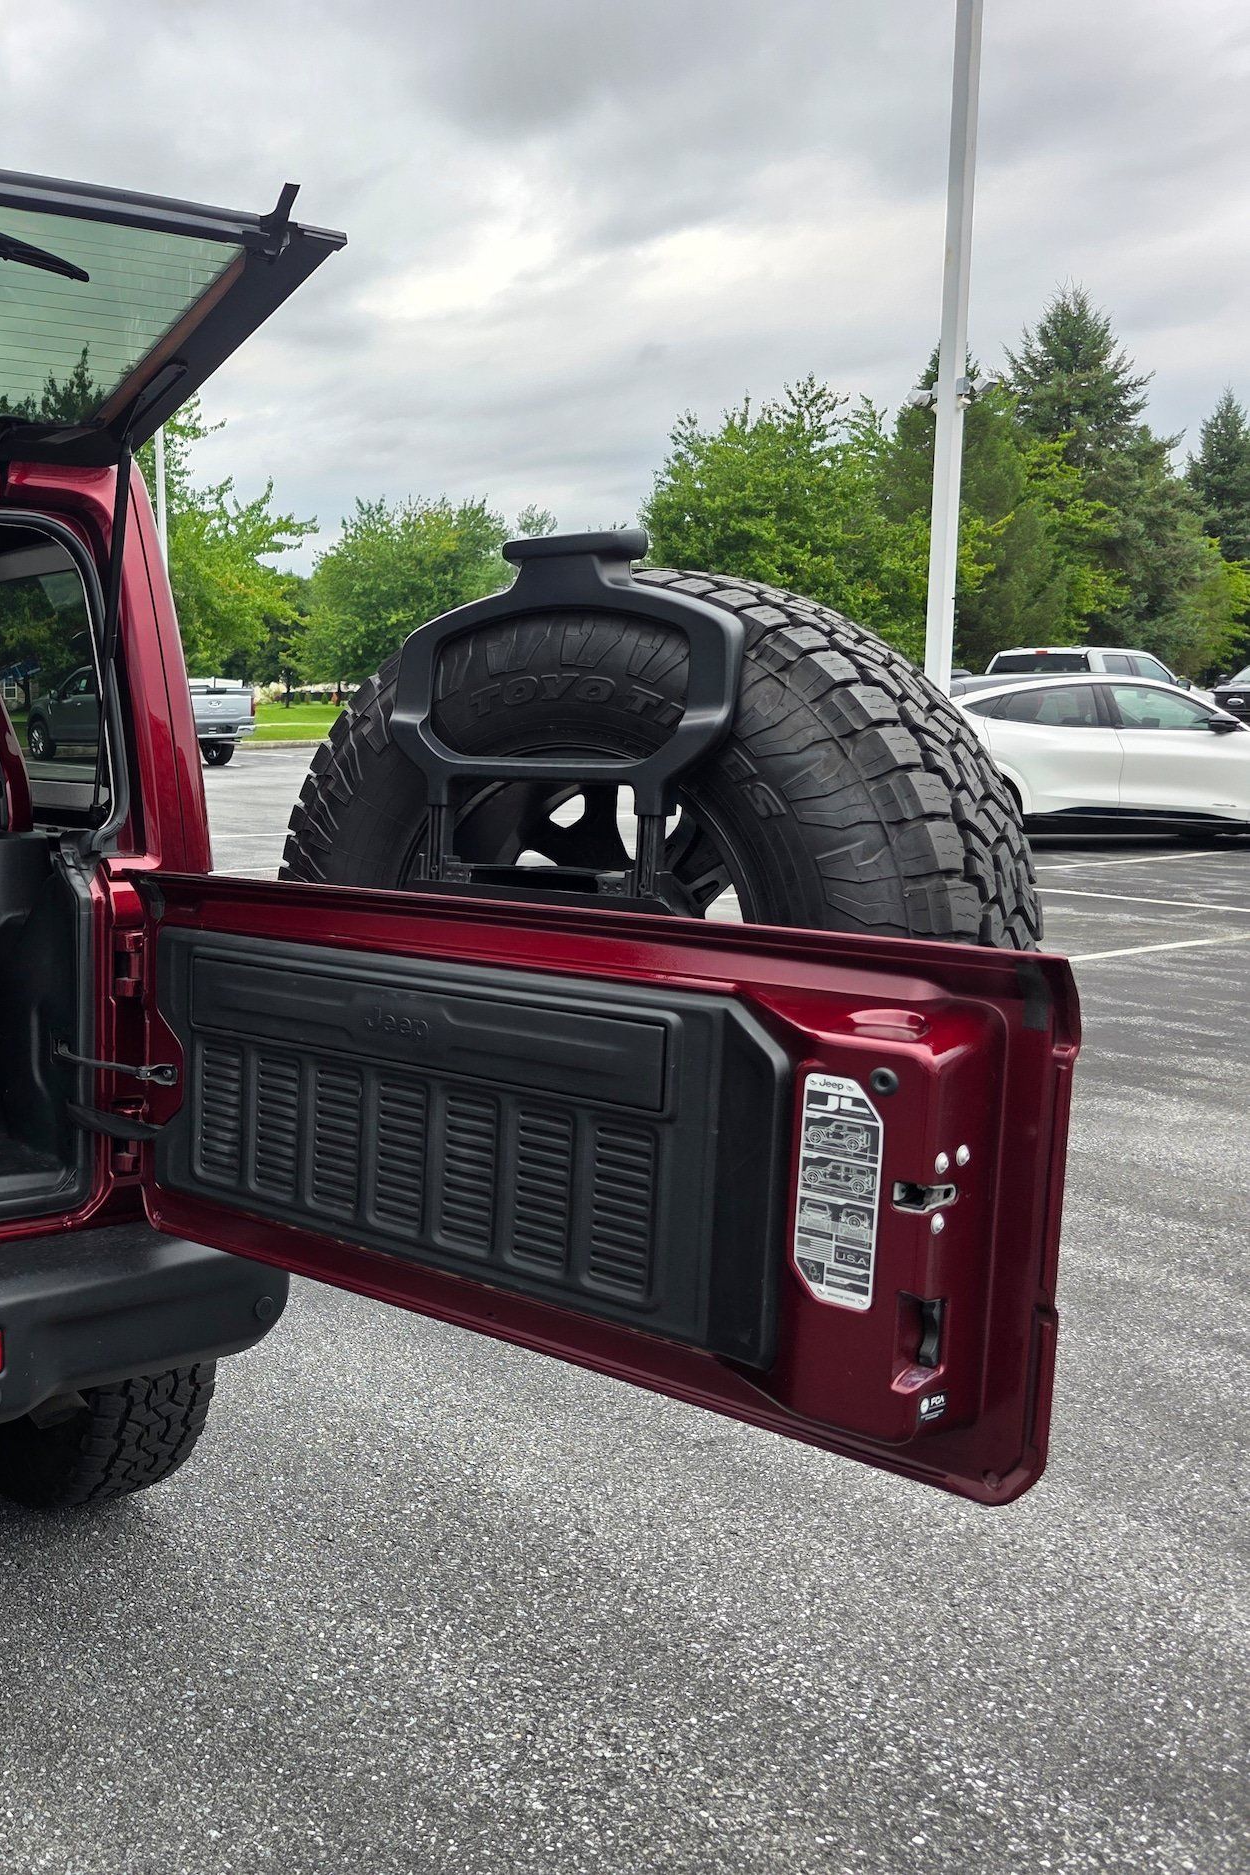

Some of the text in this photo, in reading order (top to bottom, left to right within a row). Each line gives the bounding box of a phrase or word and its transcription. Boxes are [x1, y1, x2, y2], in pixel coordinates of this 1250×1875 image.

[470, 673, 616, 717] TOYO
[364, 1007, 430, 1039] Jeep
[819, 1079, 844, 1091] Jeep
[807, 1095, 870, 1114] JL
